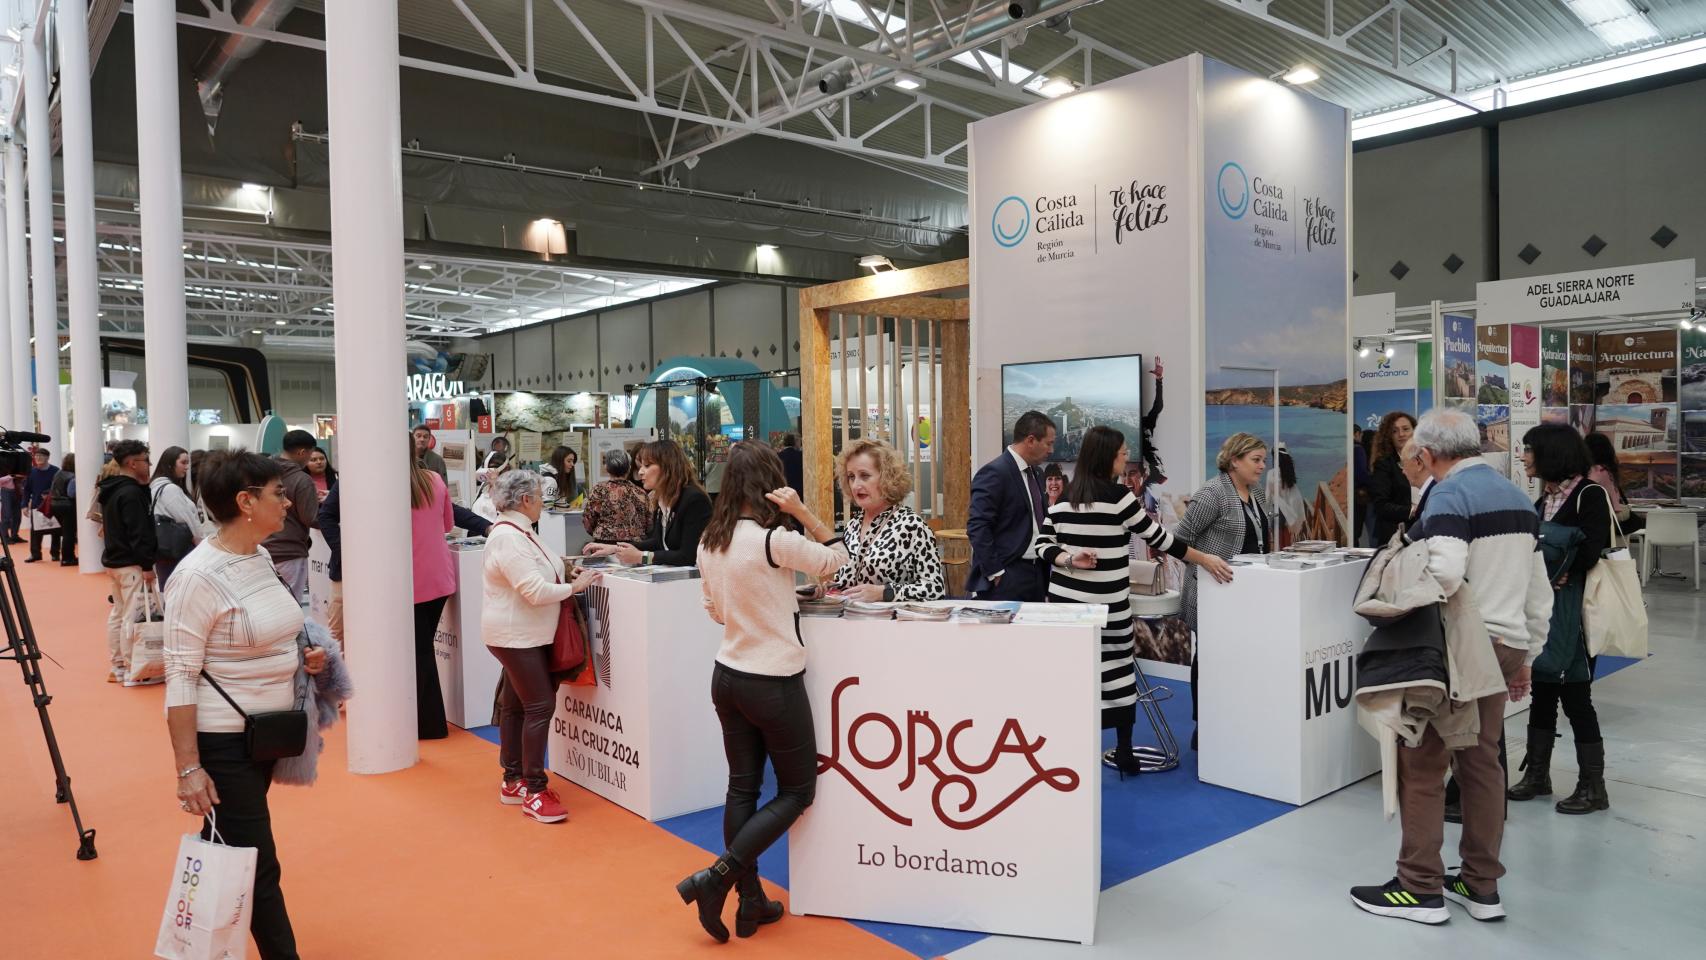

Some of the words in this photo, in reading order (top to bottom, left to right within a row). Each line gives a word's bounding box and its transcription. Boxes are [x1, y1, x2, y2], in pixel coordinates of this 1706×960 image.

[1129, 180, 1166, 204] hace
[1253, 176, 1283, 199] Costa
[1036, 195, 1077, 214] Costa
[1253, 199, 1288, 223] Cálida
[1315, 198, 1335, 223] hace
[1036, 212, 1084, 234] Cálida
[1112, 202, 1168, 244] feliz
[1254, 224, 1274, 237] Región
[1305, 216, 1336, 252] feliz
[1037, 239, 1063, 252] Región
[1254, 238, 1262, 248] de
[1263, 240, 1281, 251] Murcia
[1037, 254, 1047, 263] de
[1049, 249, 1074, 261] Murcia
[1527, 283, 1553, 296] ADEL
[1557, 279, 1593, 294] SIERRA
[1597, 274, 1635, 289] NORTE
[1540, 290, 1620, 308] GUADALAJARA
[1444, 336, 1471, 353] Pueblos
[1478, 341, 1508, 355] Arquitectura
[1599, 349, 1674, 363] Arquitectura
[1360, 368, 1408, 379] GranCanaria
[312, 559, 323, 572] mar
[564, 696, 623, 734] CARAVACA
[555, 717, 567, 737] DE
[569, 722, 580, 743] LA
[582, 729, 609, 756] CRUZ
[612, 741, 640, 769] 2024
[817, 676, 1080, 830] LORCA
[565, 747, 586, 772] AÑO
[587, 757, 627, 792] JUBILAR
[857, 844, 885, 867] Lo
[893, 845, 1018, 878] bordamos
